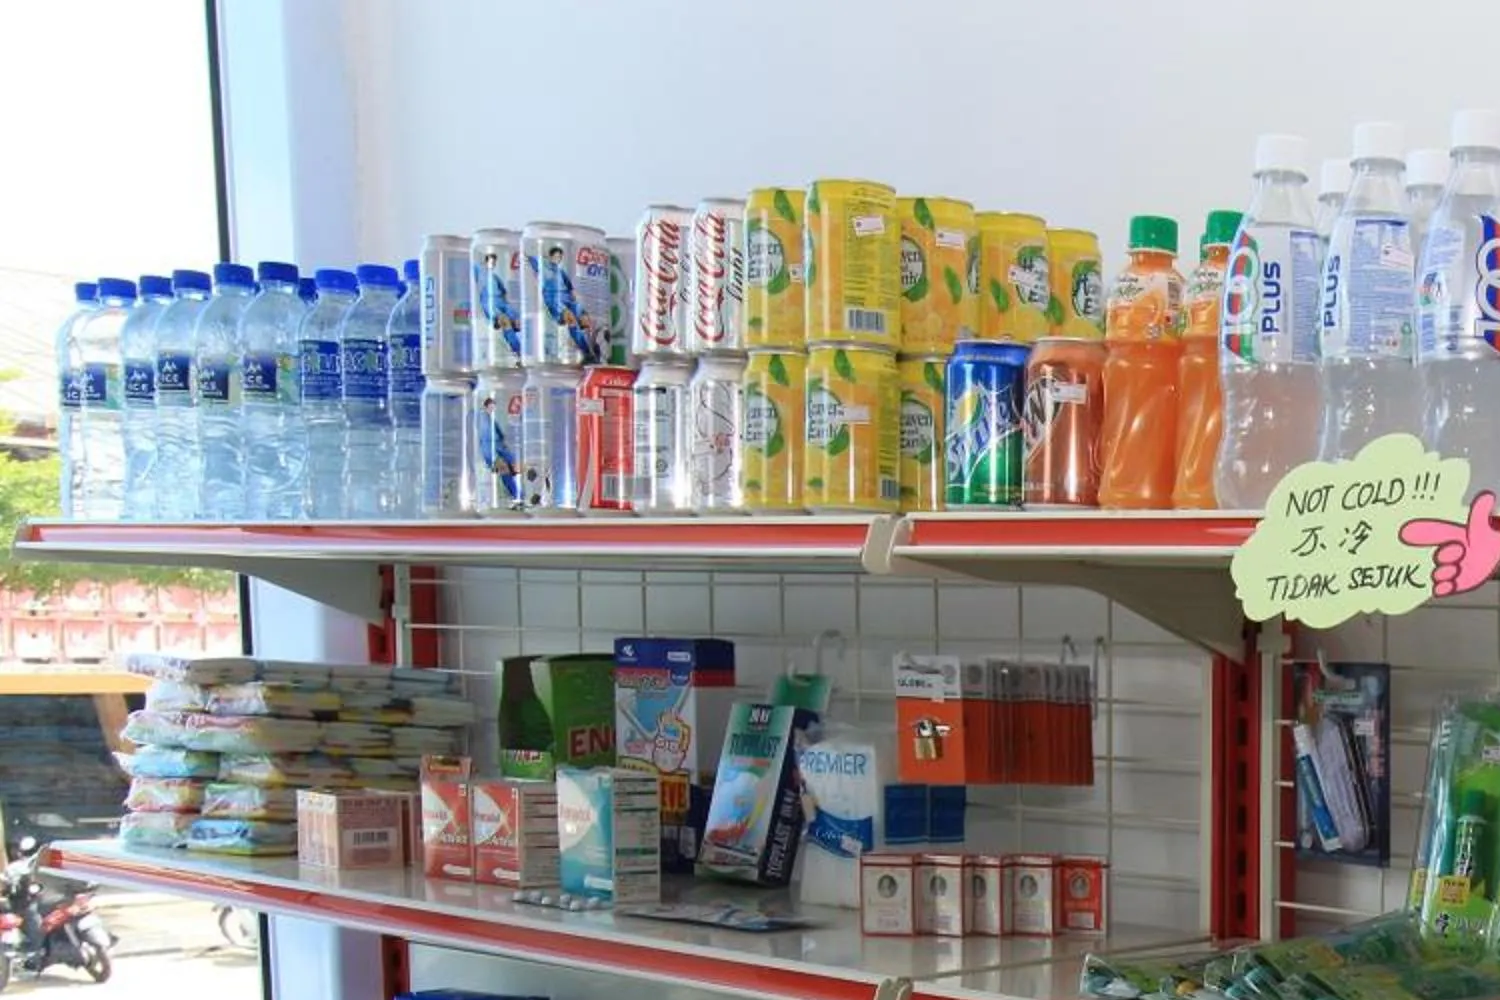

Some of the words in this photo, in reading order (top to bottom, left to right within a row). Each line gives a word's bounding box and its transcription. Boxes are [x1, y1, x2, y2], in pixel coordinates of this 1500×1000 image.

[1262, 261, 1282, 333] PLUS
[1323, 254, 1341, 328] PLUS
[1285, 485, 1334, 517] NOT
[1341, 478, 1405, 511] COLD
[1266, 573, 1340, 601] TIDAK
[1348, 564, 1427, 592] SEJUK
[569, 724, 617, 760] EN
